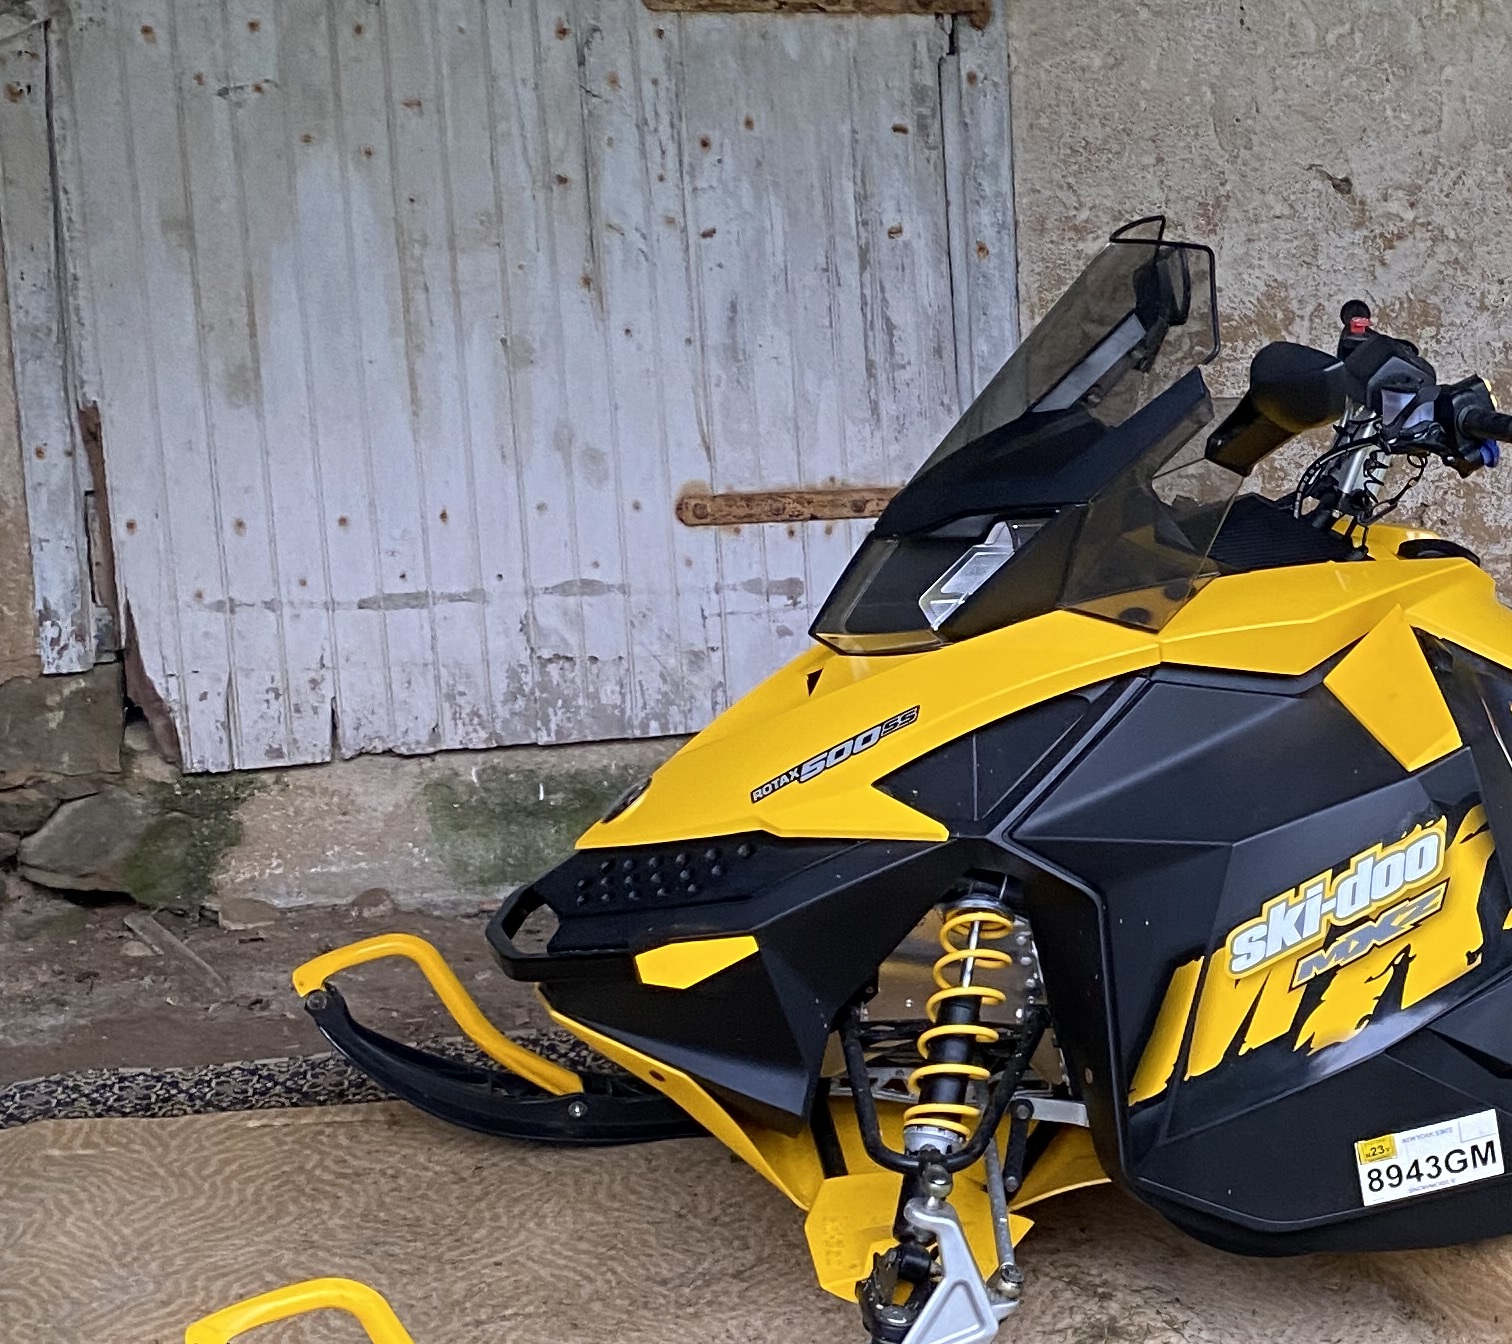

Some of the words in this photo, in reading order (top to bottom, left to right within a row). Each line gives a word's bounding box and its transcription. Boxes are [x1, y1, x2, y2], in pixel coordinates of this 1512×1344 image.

[752, 767, 800, 801] ROTAX
[1230, 832, 1441, 974] ski-doo
[1367, 1139, 1497, 1193] 8943GM
[1370, 1144, 1385, 1157] 23
